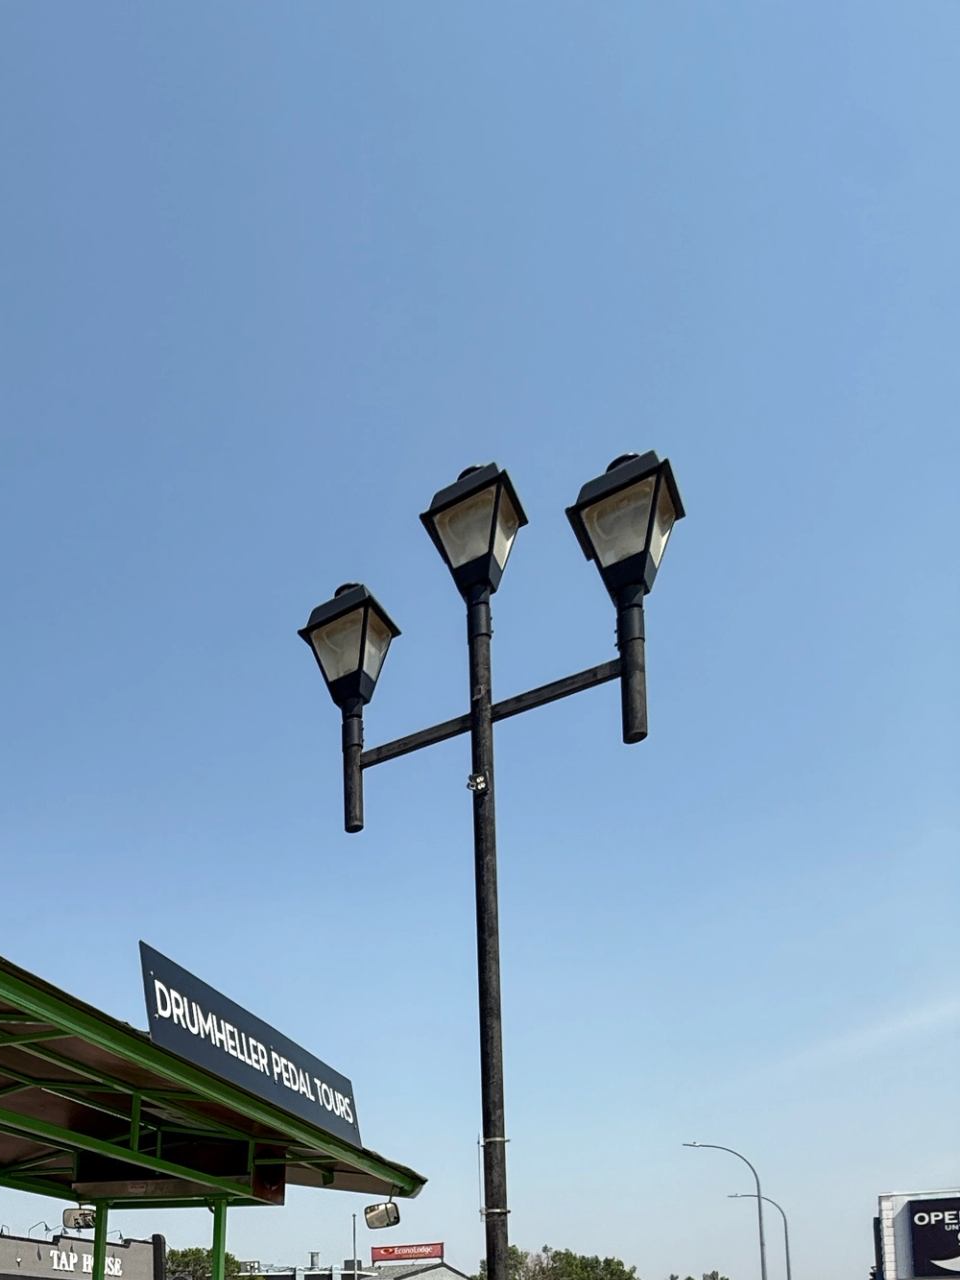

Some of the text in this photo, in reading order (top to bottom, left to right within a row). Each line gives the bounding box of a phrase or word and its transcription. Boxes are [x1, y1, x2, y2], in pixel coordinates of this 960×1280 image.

[154, 980, 354, 1124] DRUMHELLER PEDAL TOURS
[913, 1210, 960, 1226] OPE
[944, 1223, 960, 1231] UN
[49, 1250, 79, 1272] TAP
